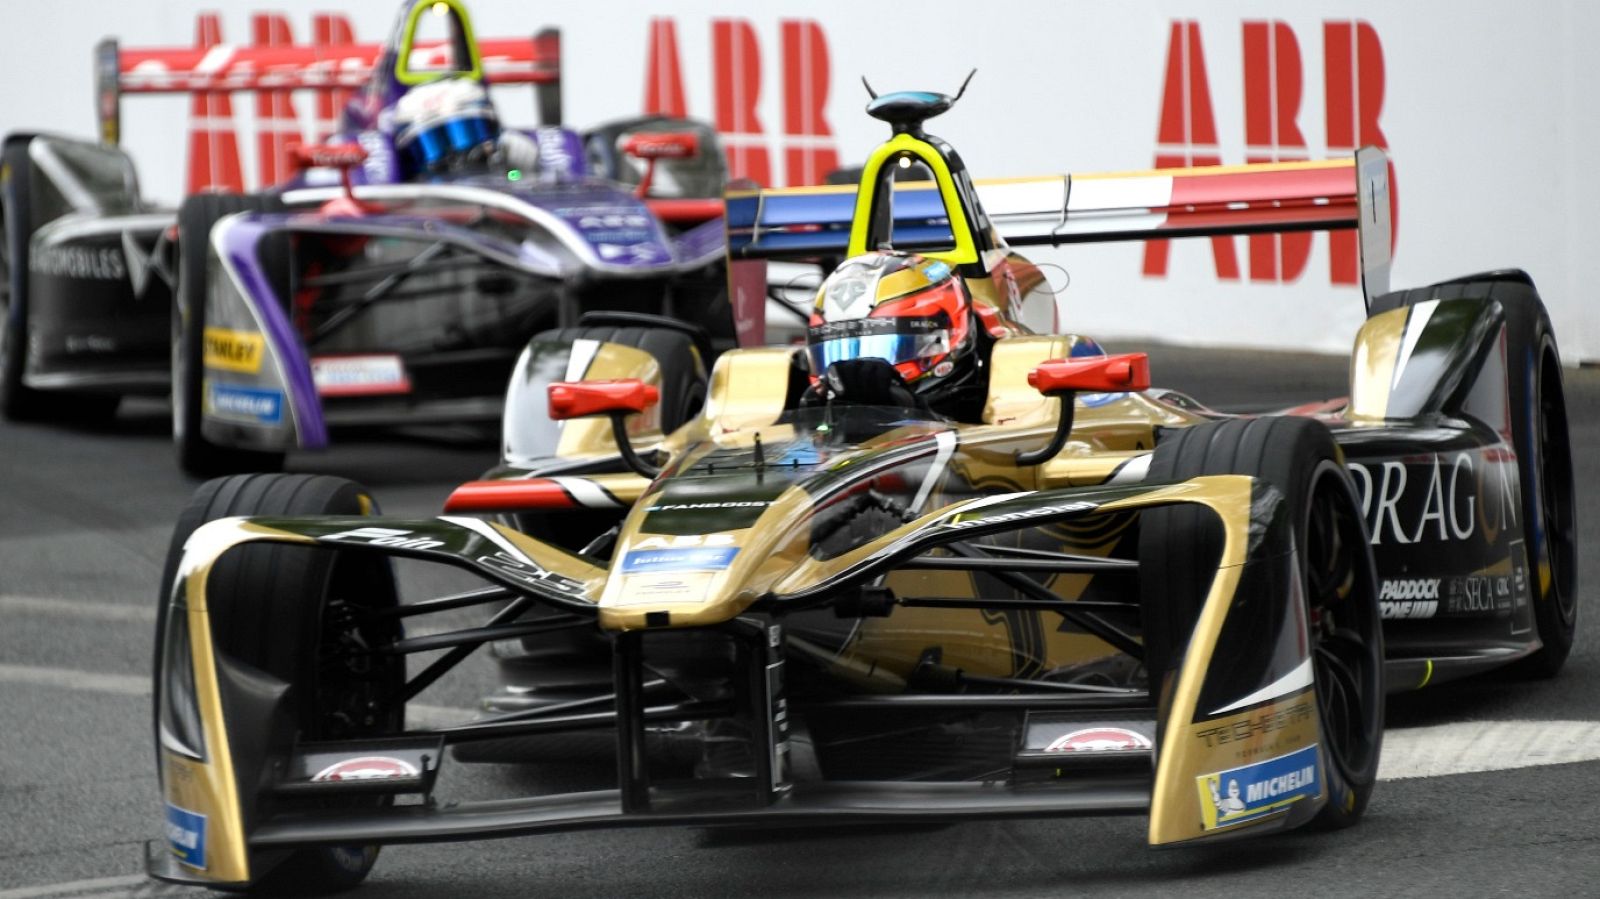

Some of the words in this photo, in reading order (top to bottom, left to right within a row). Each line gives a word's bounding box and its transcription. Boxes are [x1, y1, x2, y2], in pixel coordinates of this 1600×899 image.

[1141, 18, 1399, 287] ABB
[662, 500, 777, 510] FANBOOST
[1379, 577, 1441, 600] PADDOCK
[1464, 577, 1495, 611] SECA
[1246, 765, 1315, 803] MICHELIN
